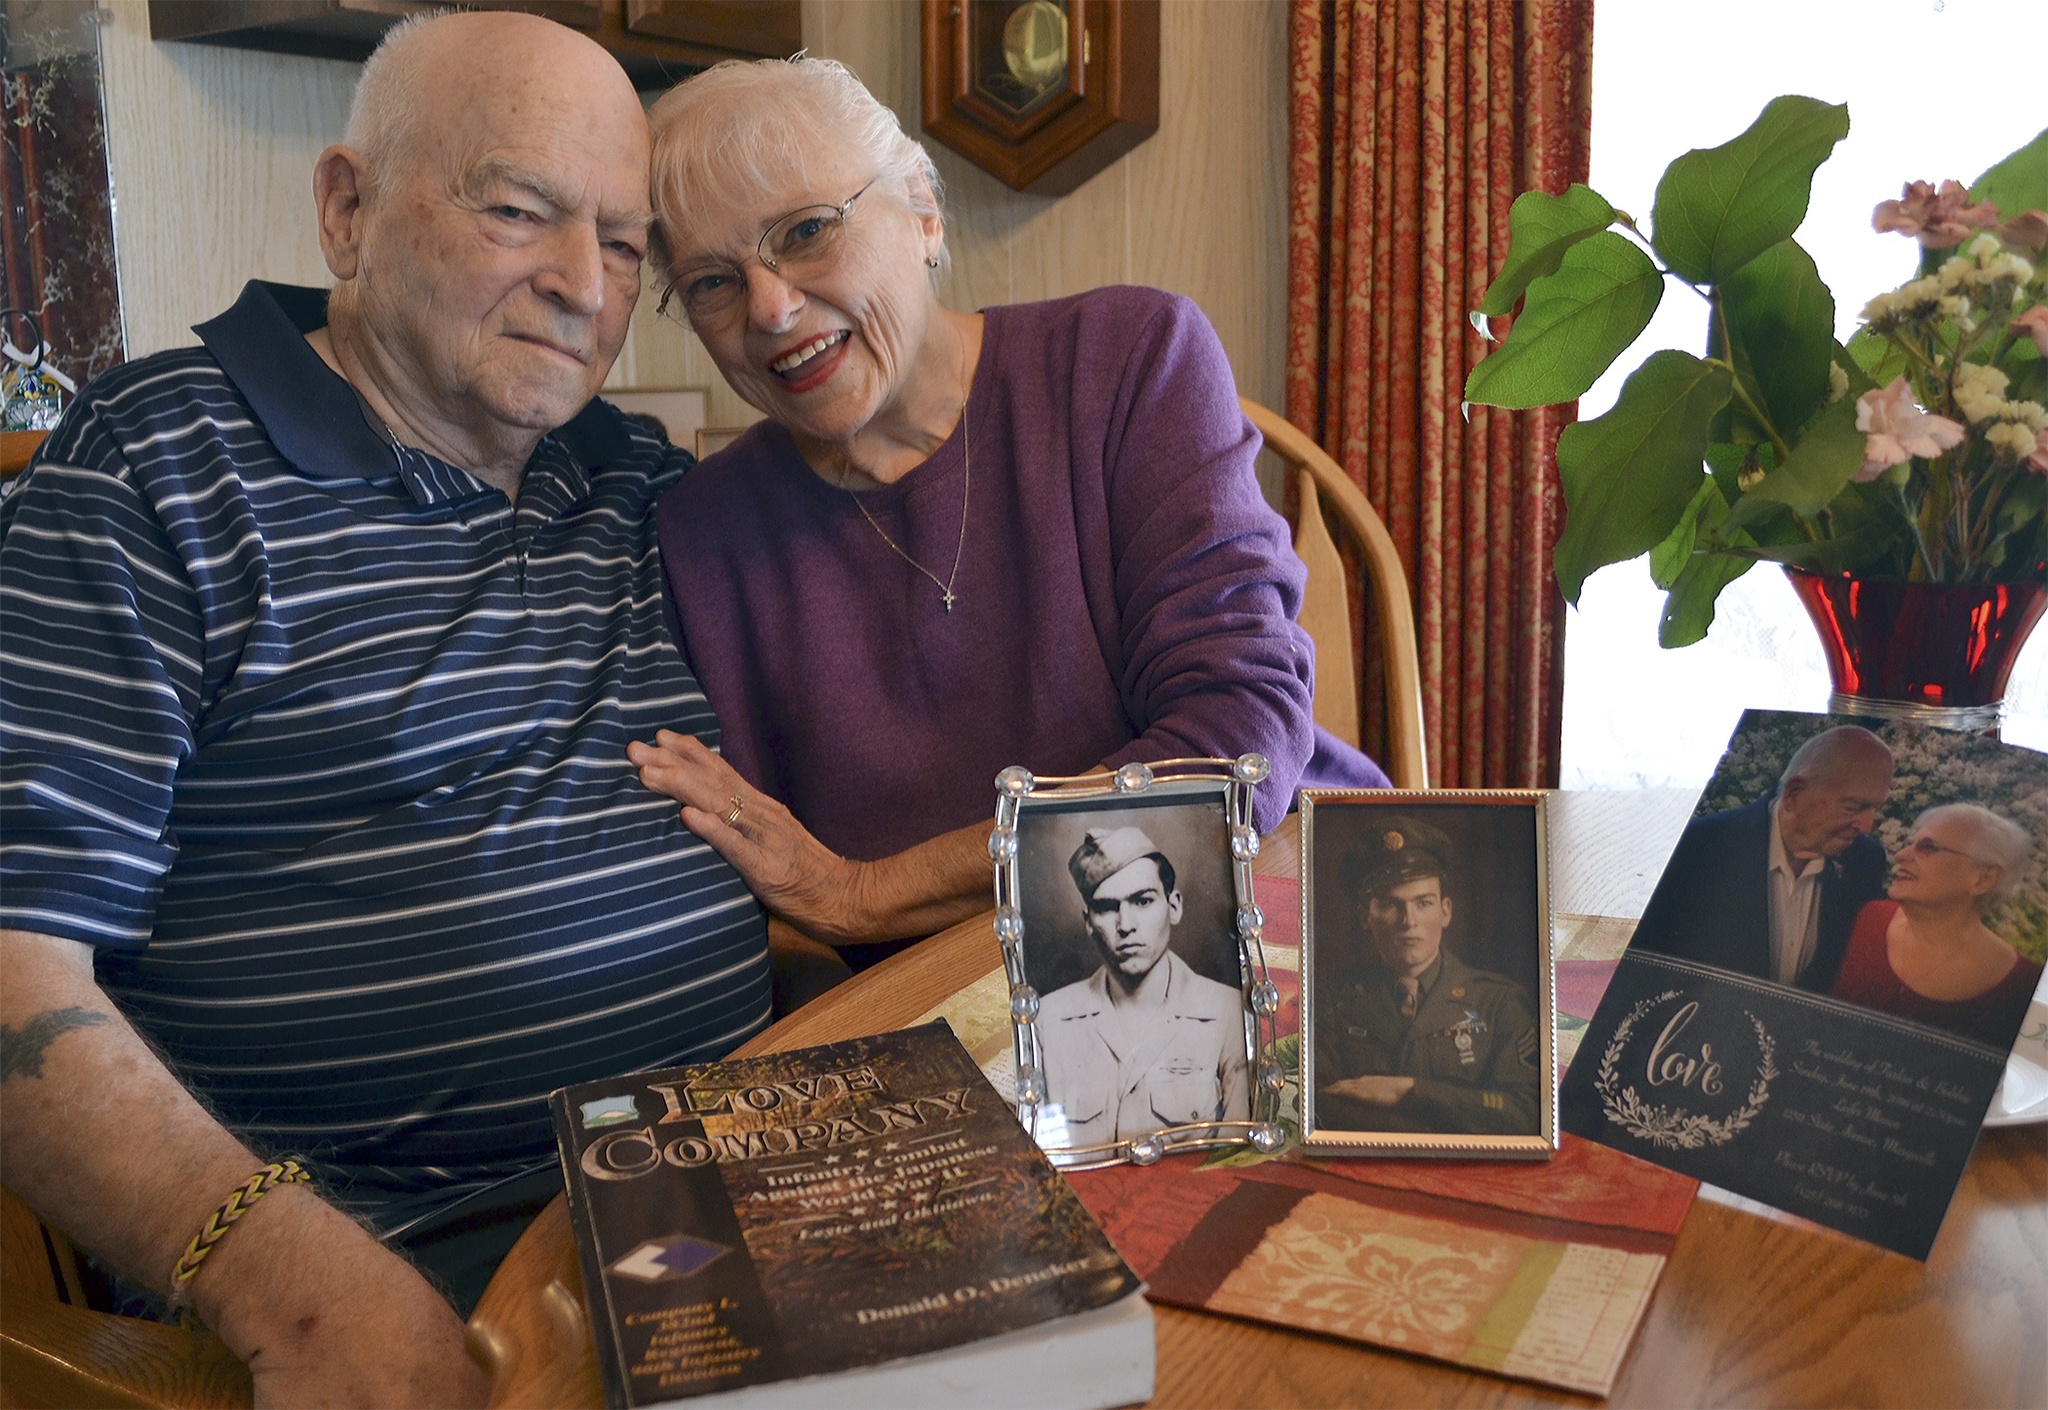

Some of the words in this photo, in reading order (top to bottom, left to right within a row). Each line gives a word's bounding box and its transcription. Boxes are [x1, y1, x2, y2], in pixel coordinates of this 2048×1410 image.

[1646, 1001, 1723, 1096] love
[647, 1066, 888, 1124] LOVE
[580, 1088, 977, 1181] COMPANY
[750, 1178, 838, 1203] Against
[848, 1172, 885, 1186] the
[892, 1148, 997, 1174] Japanese
[768, 1161, 864, 1188] Infantry
[874, 1140, 967, 1164] Combat
[800, 1188, 873, 1209] World
[884, 1176, 934, 1192] War
[904, 1195, 990, 1217] Okinawa
[857, 1291, 947, 1324] Donald
[952, 1283, 986, 1302] O.
[990, 1257, 1089, 1290] Dencker
